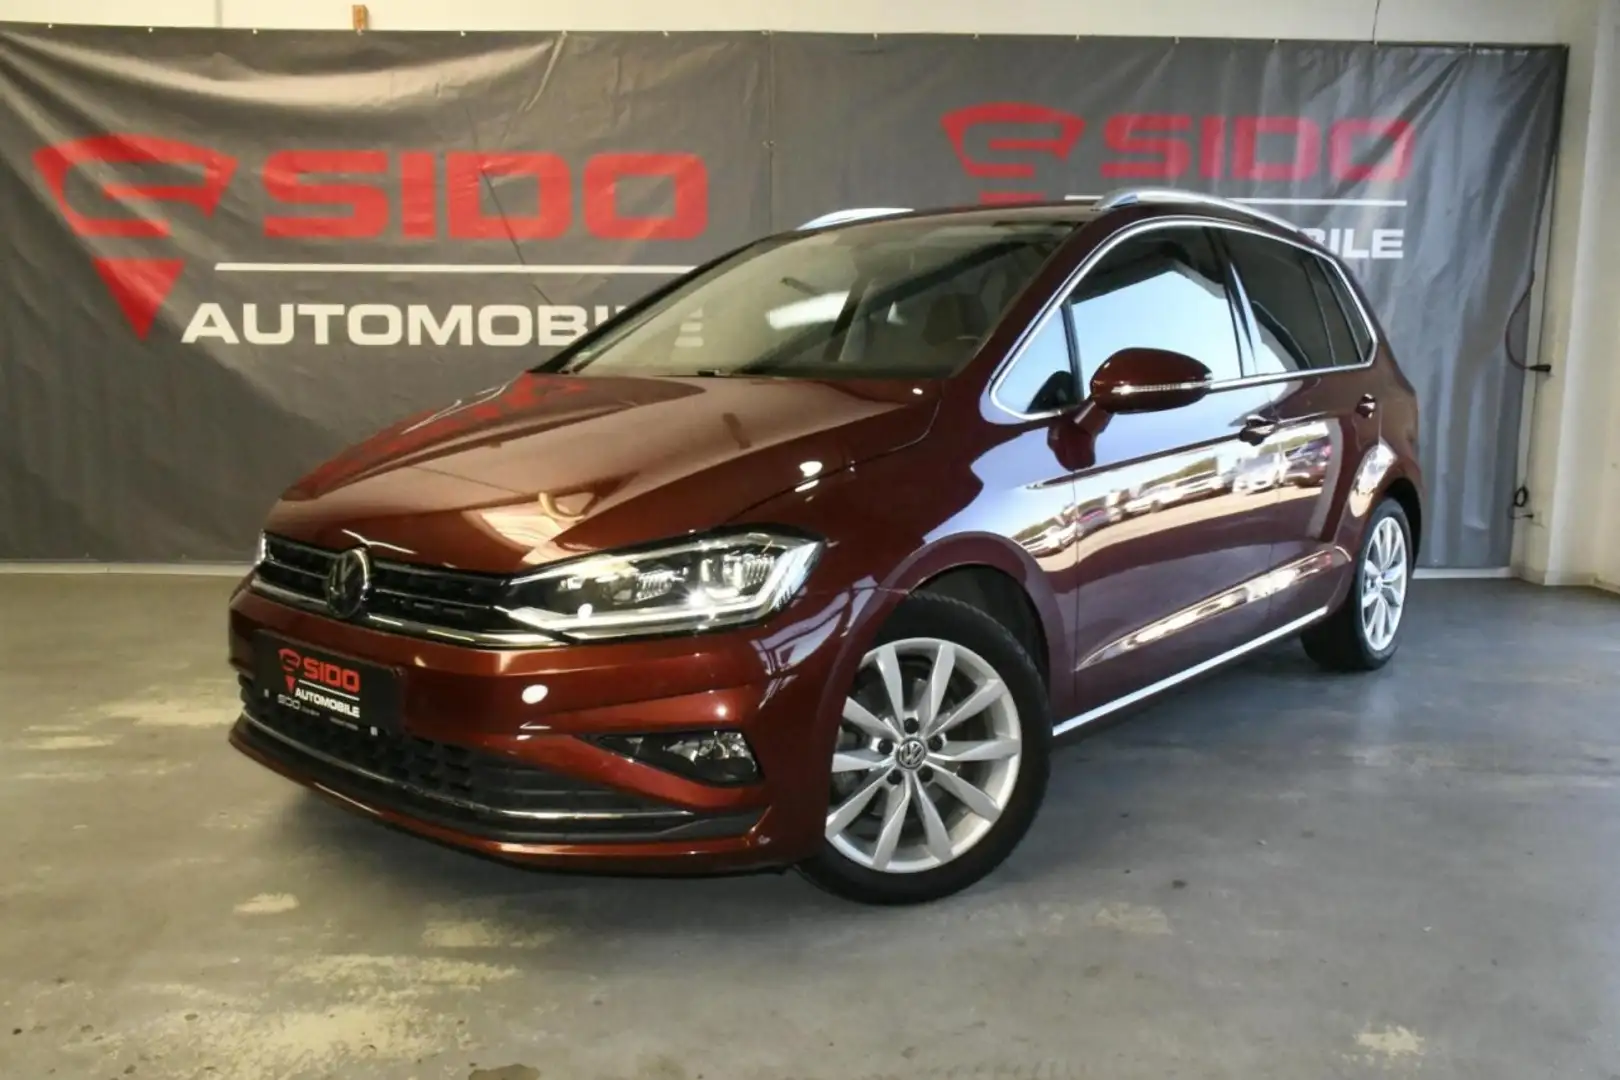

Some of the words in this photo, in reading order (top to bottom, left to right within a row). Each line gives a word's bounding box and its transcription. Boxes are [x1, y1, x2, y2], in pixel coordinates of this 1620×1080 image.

[1101, 114, 1415, 181] SIDO
[263, 149, 709, 240] SIDO
[182, 302, 704, 347] AUTOMOB
[303, 657, 360, 693] SIDO
[295, 687, 361, 718] AUTOMOBILE
